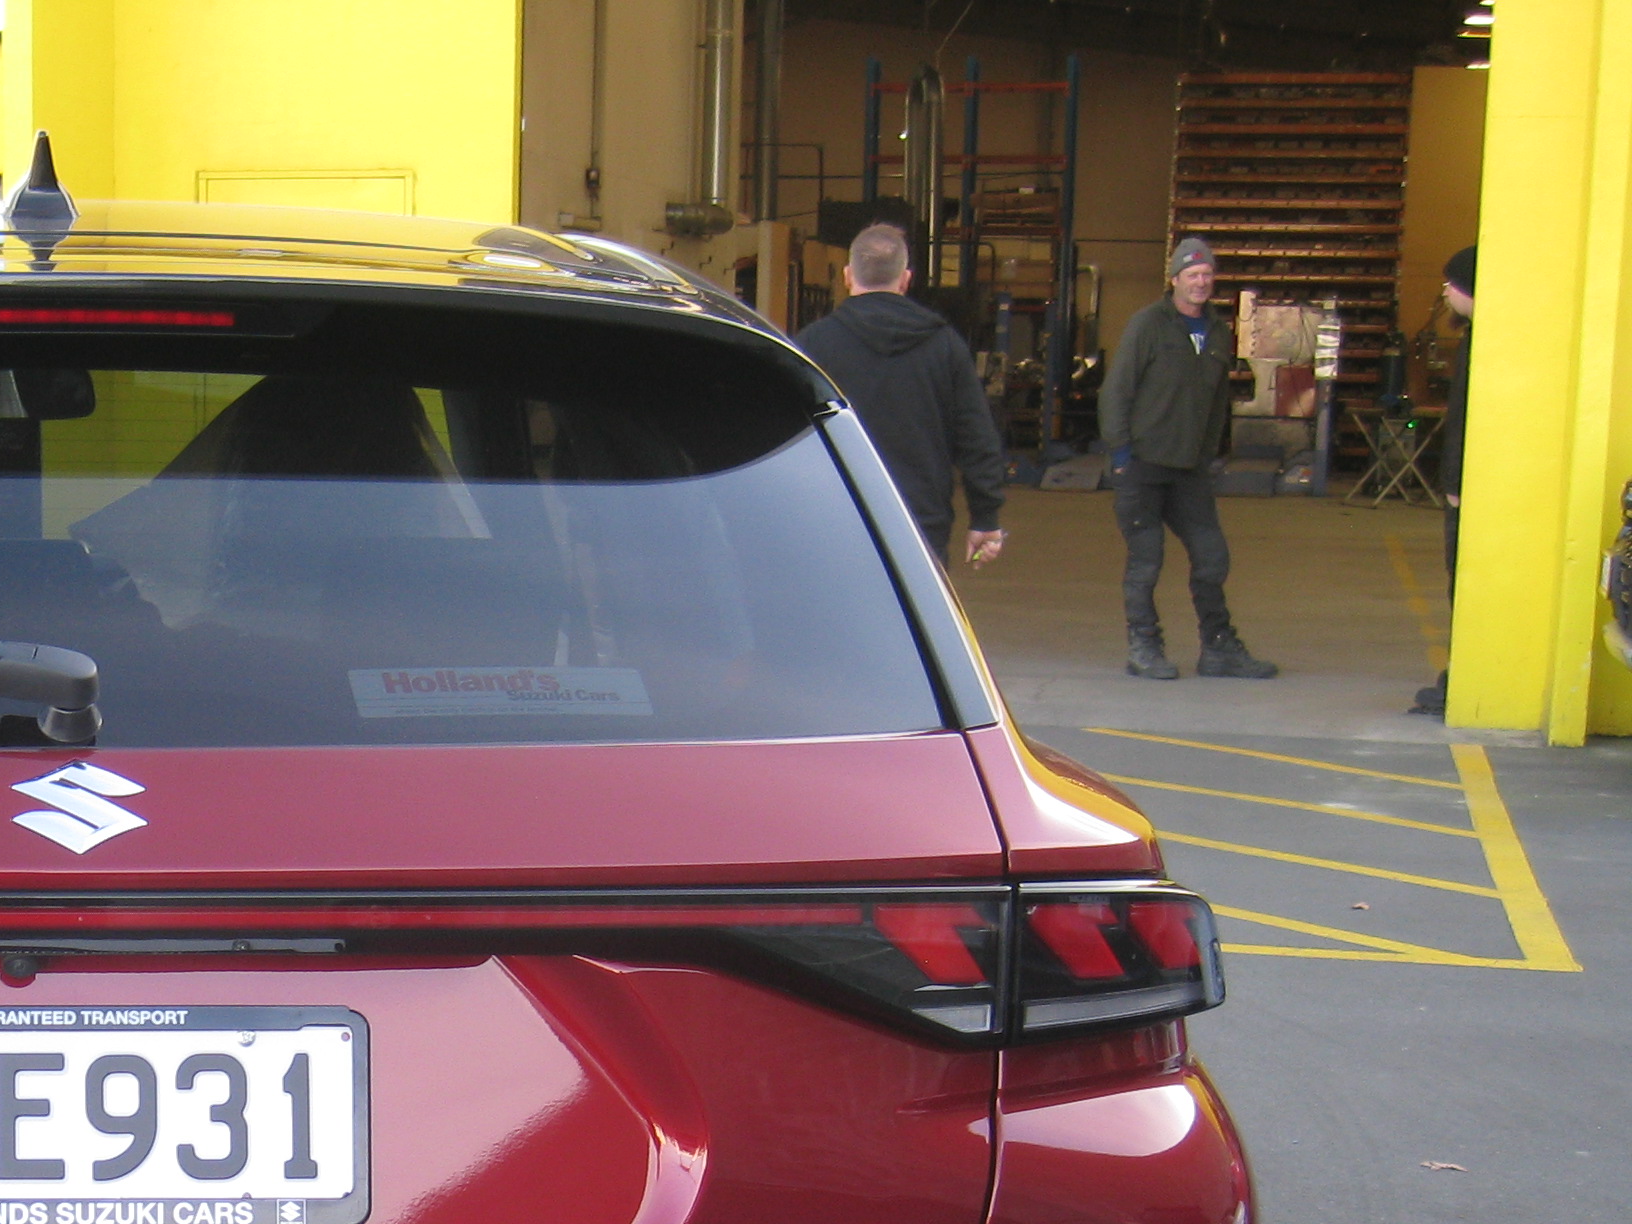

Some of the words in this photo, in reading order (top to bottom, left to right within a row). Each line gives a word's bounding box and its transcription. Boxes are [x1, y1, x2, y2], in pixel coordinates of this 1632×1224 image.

[381, 669, 561, 694] Holland's
[575, 688, 621, 701] Cars
[80, 1010, 189, 1025] TRANSPORT
